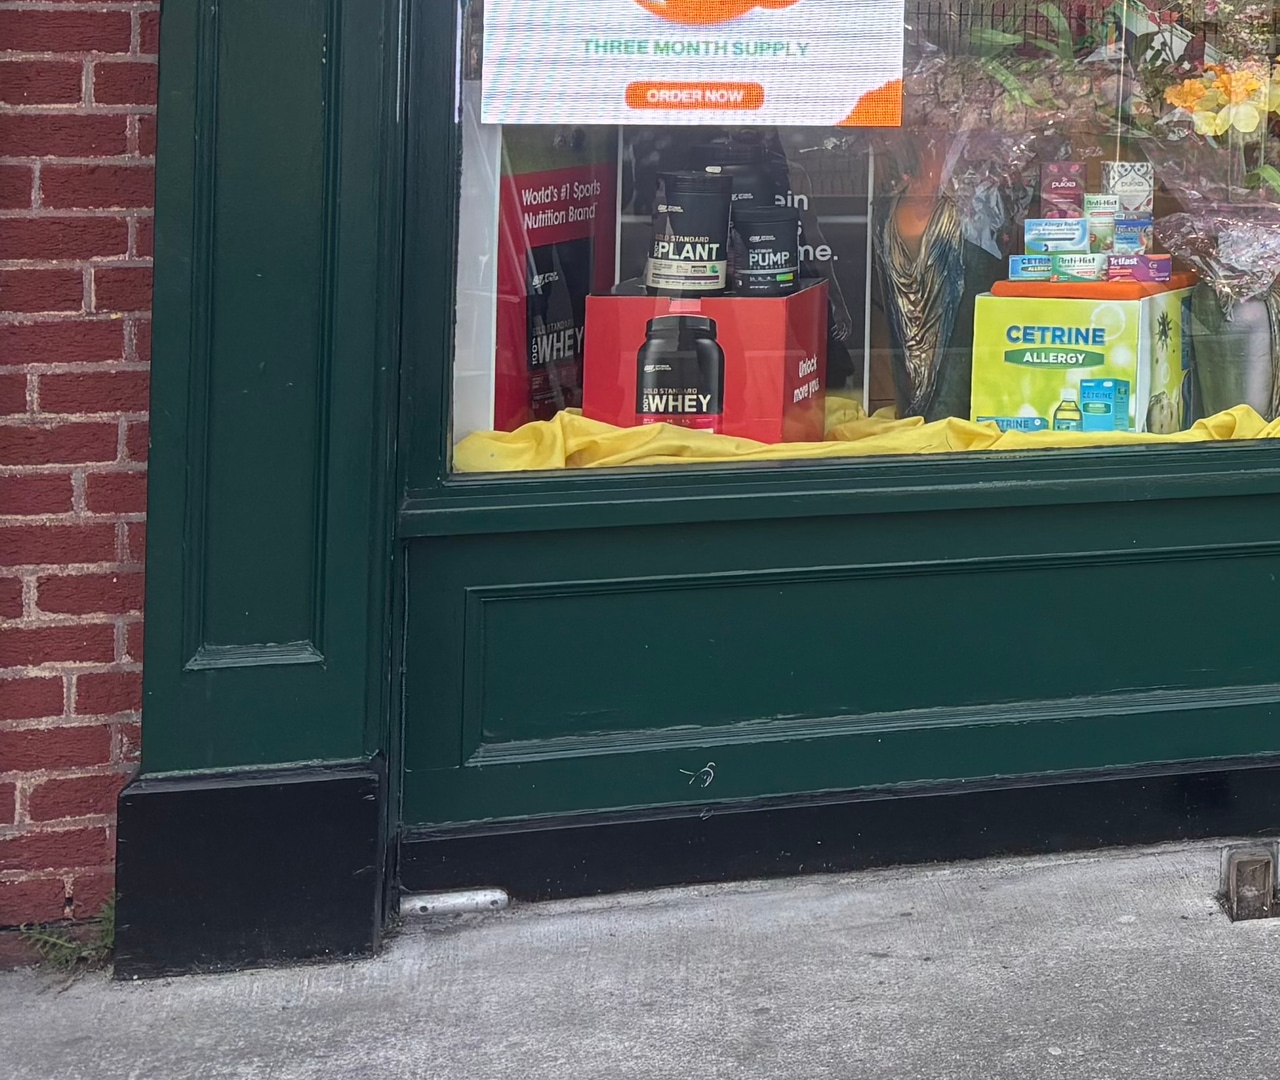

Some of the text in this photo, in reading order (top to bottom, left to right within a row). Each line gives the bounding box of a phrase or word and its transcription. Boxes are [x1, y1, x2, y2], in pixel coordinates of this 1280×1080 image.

[582, 38, 811, 58] THREE MONTH SUPPLY
[646, 88, 744, 103] ORDER NOW
[521, 184, 559, 207] World's
[572, 179, 601, 201] Sports
[523, 208, 566, 231] Nutrition
[670, 235, 710, 243] STANDARD
[658, 241, 720, 261] PLANT
[748, 251, 790, 267] PUMP
[536, 325, 585, 364] WHEY
[1006, 325, 1106, 346] CETRINE
[1023, 351, 1086, 364] ALLERGY
[648, 394, 712, 413] WHEY
